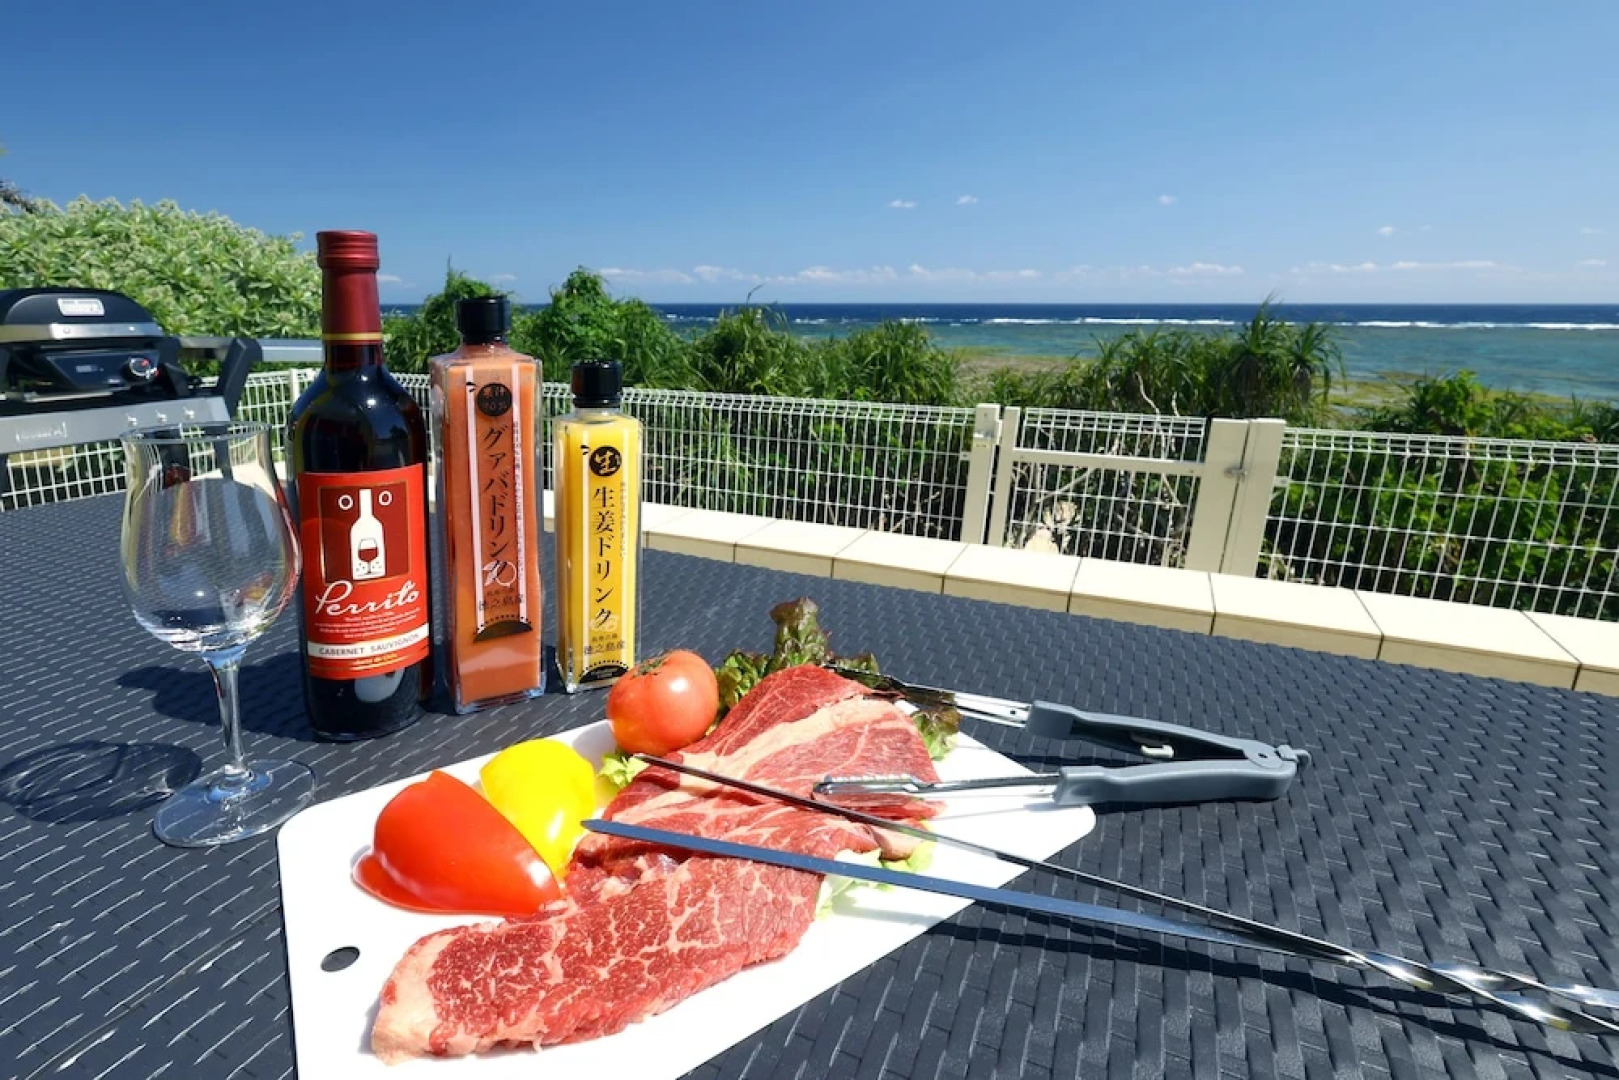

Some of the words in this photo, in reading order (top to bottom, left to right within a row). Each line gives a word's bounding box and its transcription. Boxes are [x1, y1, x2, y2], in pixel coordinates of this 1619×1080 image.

[483, 425, 509, 581] グァバドリンク
[315, 579, 420, 616] Perrito
[592, 485, 615, 628] 生姜ドリンク
[318, 647, 365, 656] CABERNET
[370, 632, 420, 653] SAUVIGNON
